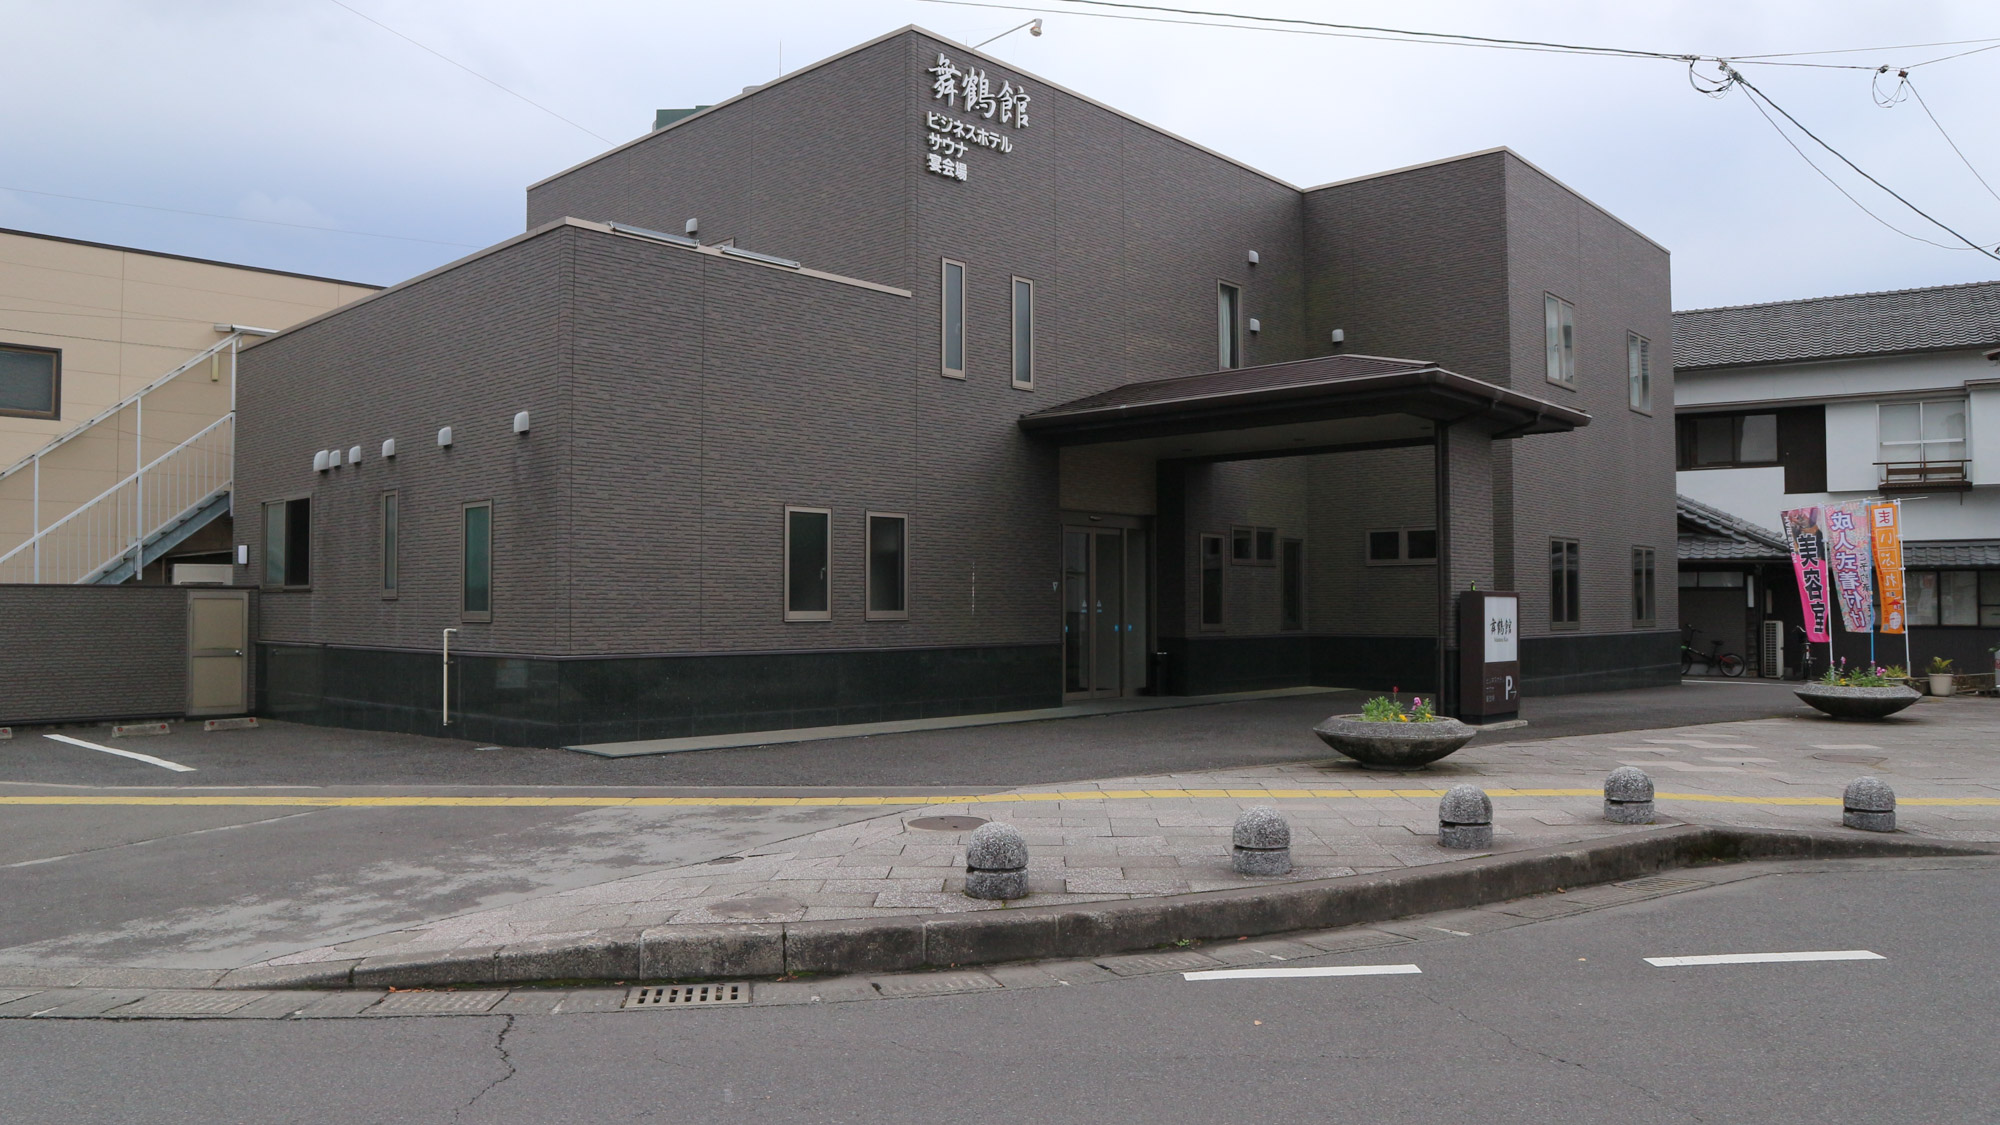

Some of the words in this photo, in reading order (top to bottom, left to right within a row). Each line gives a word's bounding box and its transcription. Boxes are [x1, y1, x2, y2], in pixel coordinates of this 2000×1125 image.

[927, 52, 1031, 129] 舞鶴館
[927, 110, 1013, 154] ビジネスホテル
[928, 132, 968, 158] サウナ
[927, 153, 968, 181] 宴会場
[1505, 675, 1513, 701] P
